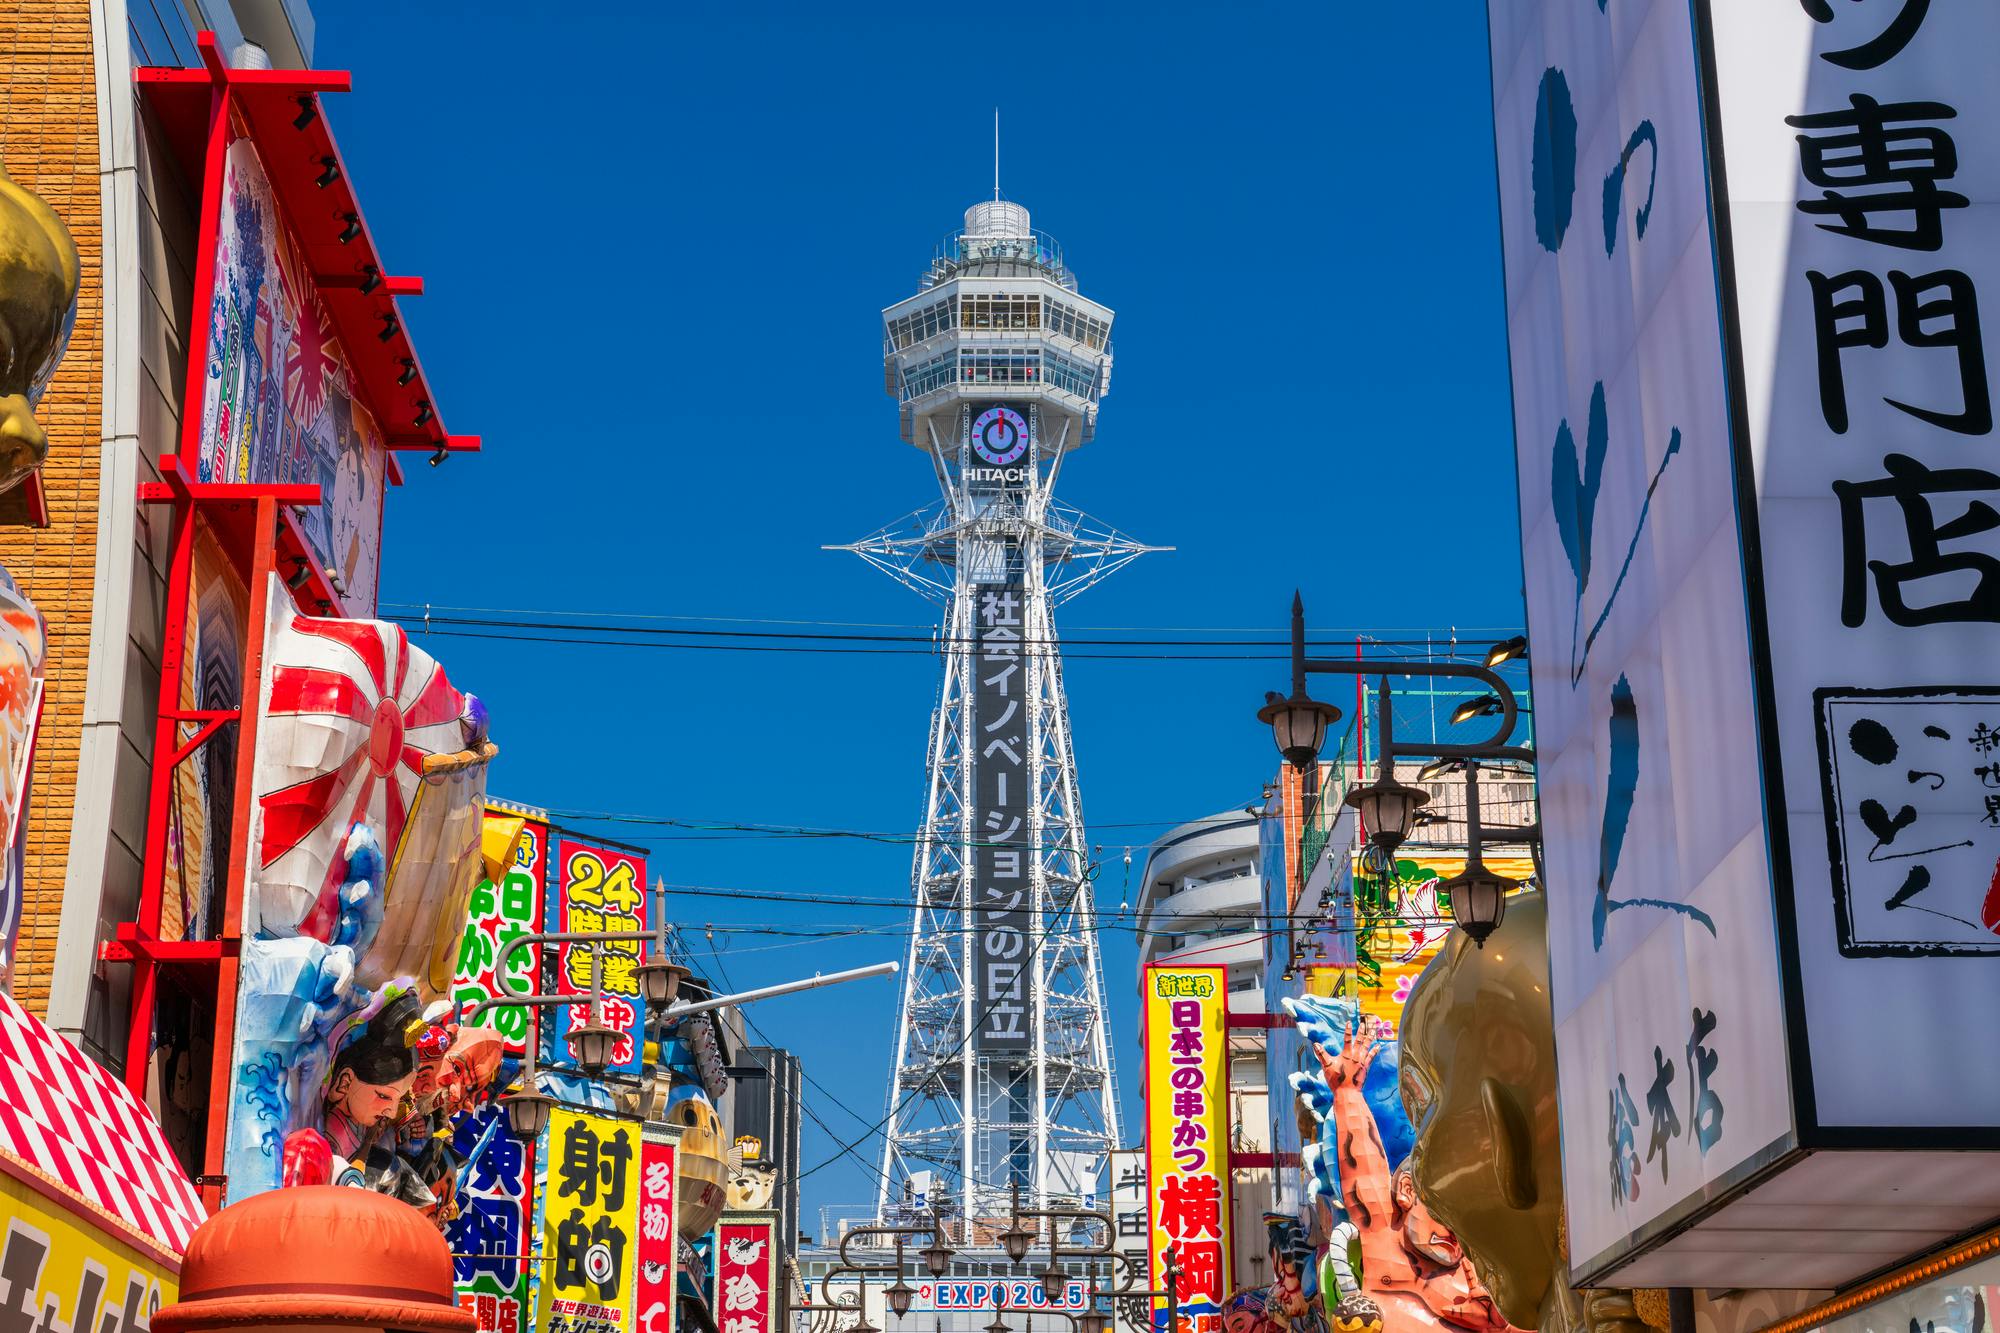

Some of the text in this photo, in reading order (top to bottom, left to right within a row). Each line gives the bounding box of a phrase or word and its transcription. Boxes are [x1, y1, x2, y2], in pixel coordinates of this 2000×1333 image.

[981, 591, 1026, 1040] 社会イノベーションの日立
[568, 853, 640, 914] 24
[568, 908, 640, 956] 時間
[1157, 974, 1214, 998] 新世界
[1170, 1000, 1206, 1172] 日本一の串かつ
[554, 1118, 633, 1302] 射的
[643, 1161, 671, 1242] 名物
[1159, 1175, 1222, 1304] 横綱
[936, 1283, 1008, 1308] EXPO
